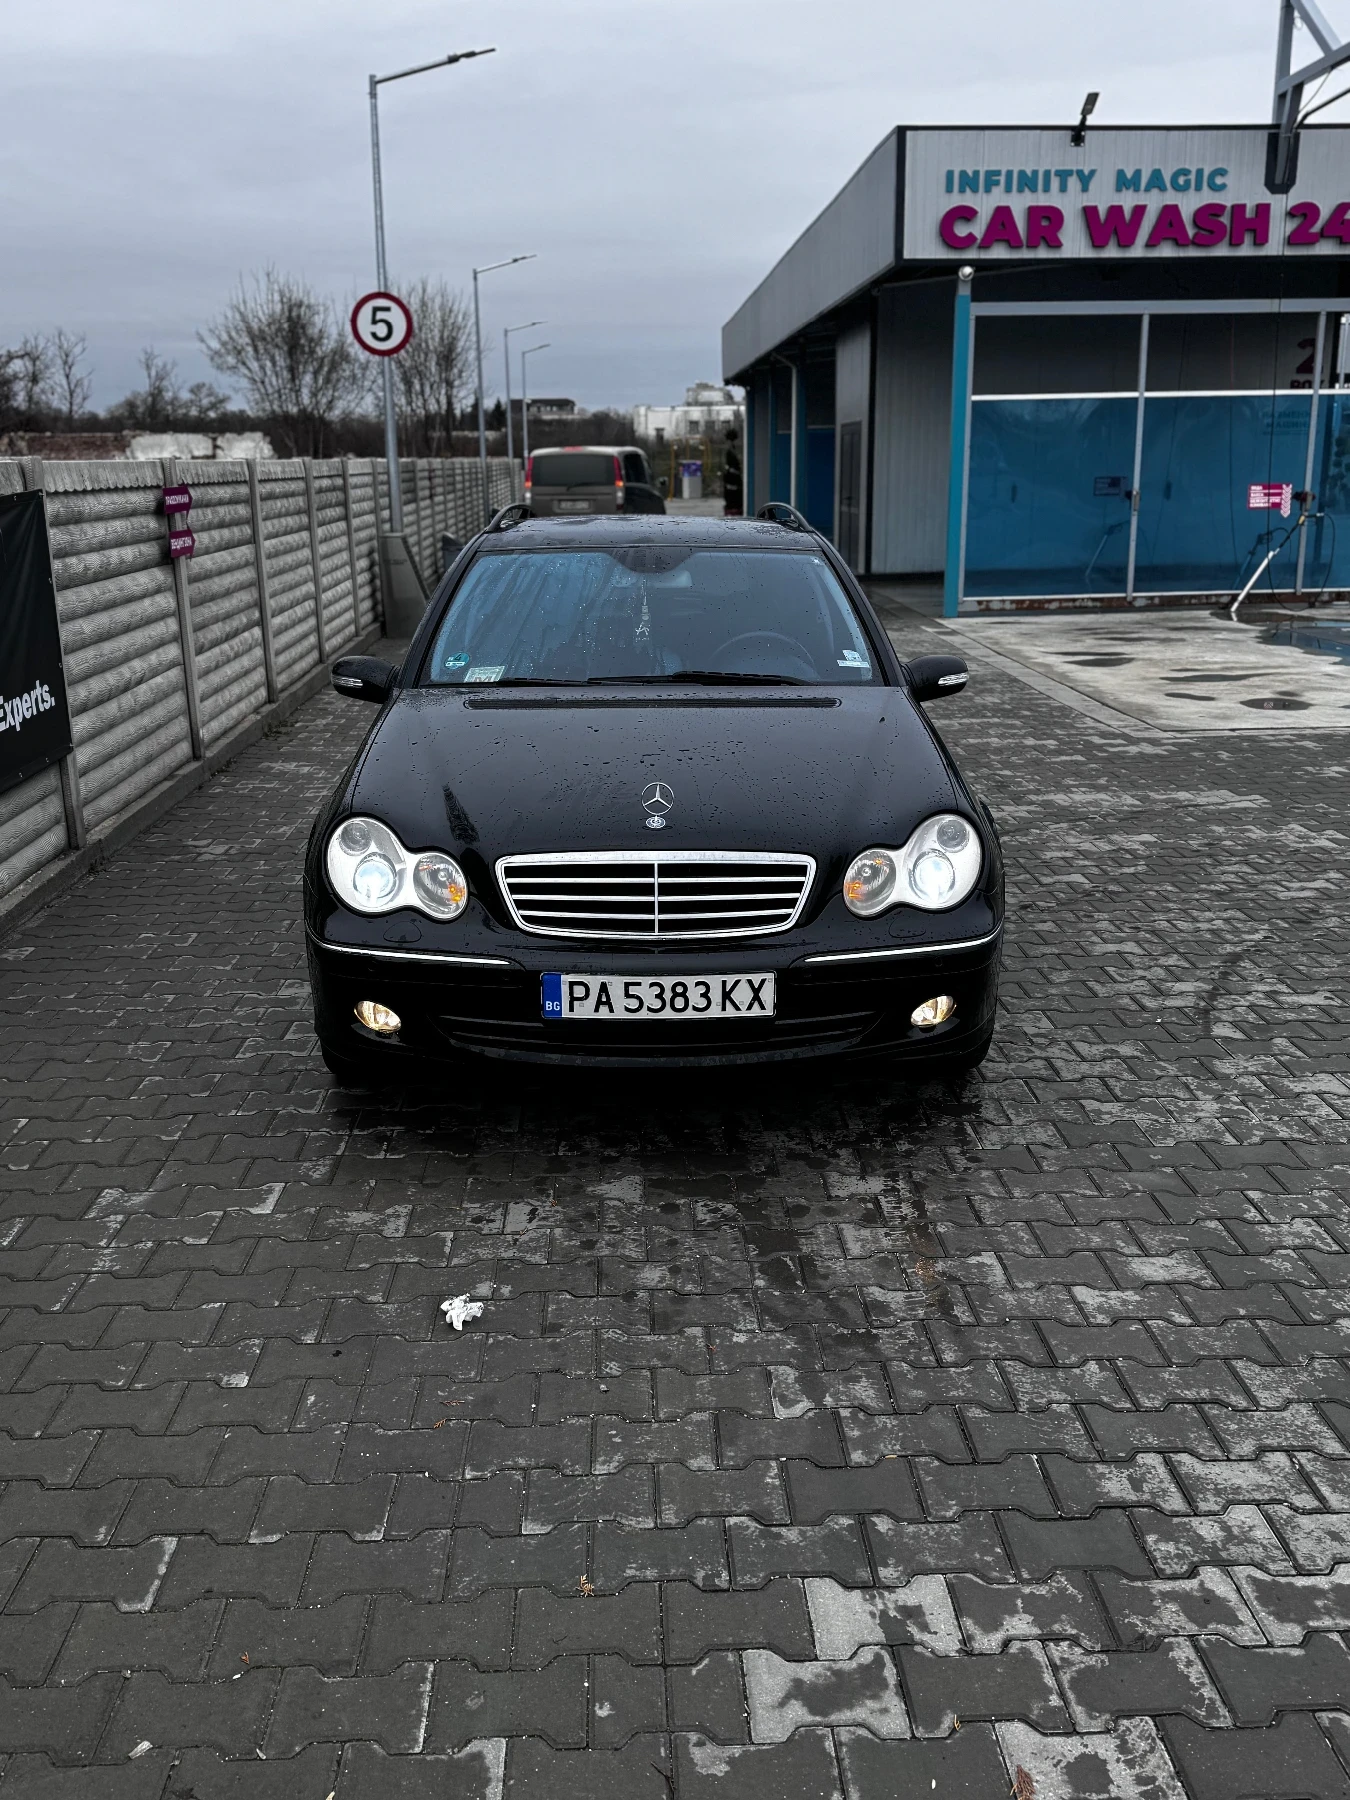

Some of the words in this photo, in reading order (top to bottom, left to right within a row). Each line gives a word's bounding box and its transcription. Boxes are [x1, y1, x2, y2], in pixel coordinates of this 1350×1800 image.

[945, 169, 1096, 194] INFINITY
[1115, 168, 1229, 192] MAGIC
[940, 205, 1065, 248] CAR
[1083, 203, 1271, 247] WASH
[1289, 202, 1350, 245] 24
[370, 306, 393, 343] 5
[545, 1001, 560, 1011] BG
[567, 980, 615, 1014] PA
[623, 980, 712, 1014] 5383
[720, 977, 768, 1012] KX
